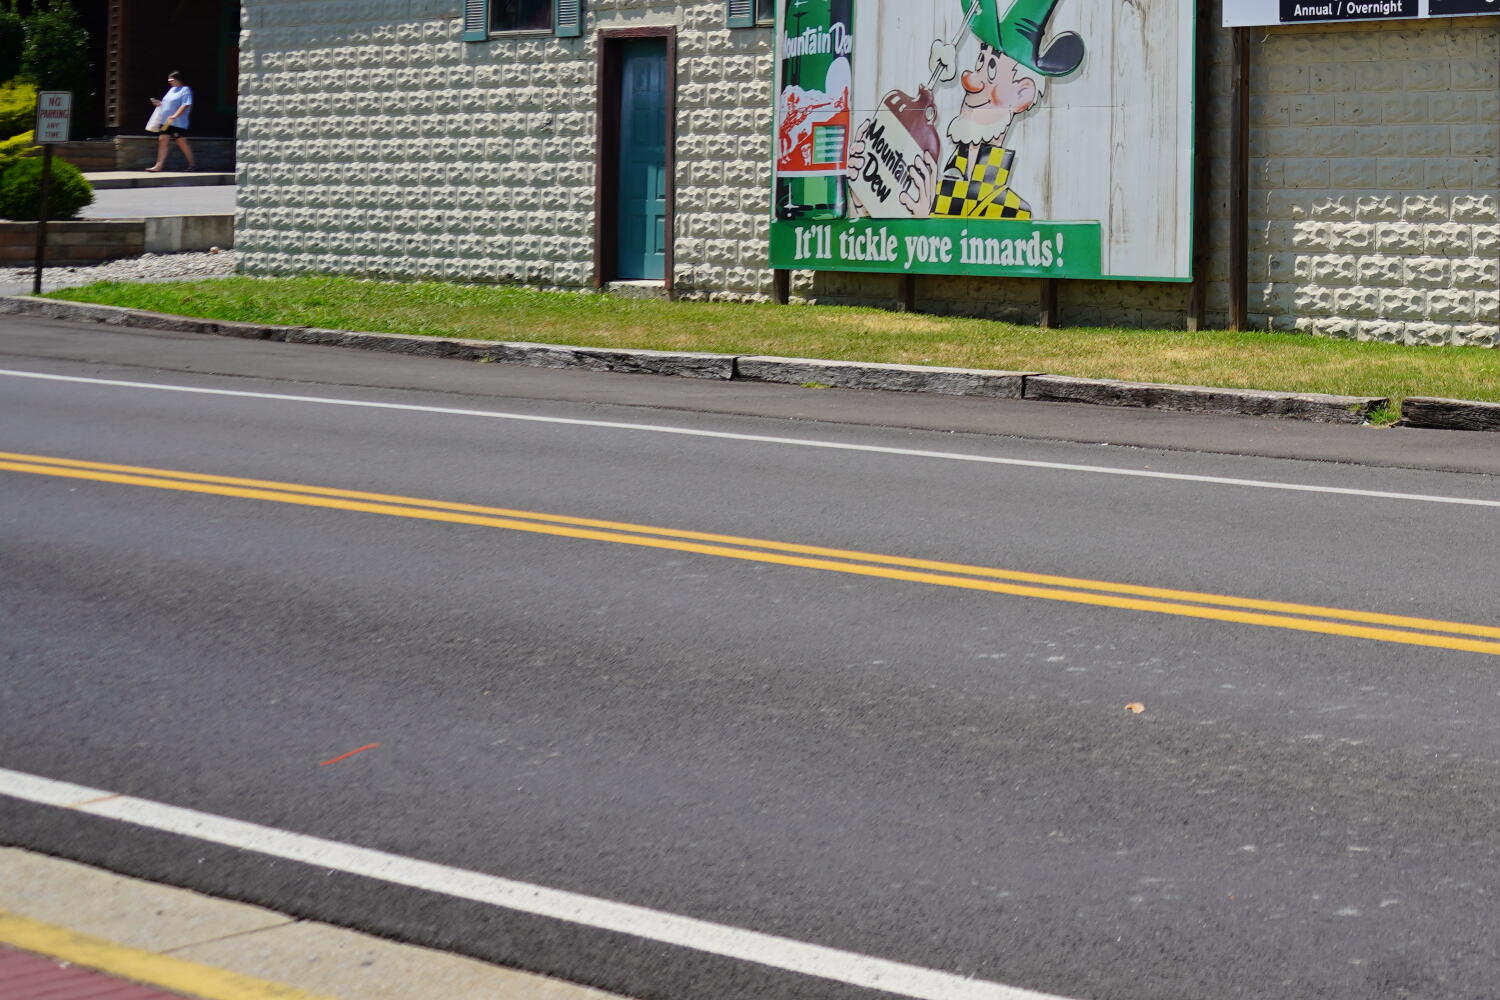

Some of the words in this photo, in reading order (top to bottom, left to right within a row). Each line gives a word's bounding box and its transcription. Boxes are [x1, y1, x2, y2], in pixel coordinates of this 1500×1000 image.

[1294, 3, 1332, 16] Annual
[1337, 2, 1342, 16] /
[1346, 0, 1402, 15] Overnight
[40, 109, 69, 118] PARKING
[48, 96, 62, 106] NO
[866, 119, 913, 192] Mountain
[863, 152, 891, 203] Dew
[794, 225, 832, 261] It'll
[839, 227, 897, 262] tickle
[903, 233, 952, 270] yore
[959, 229, 1064, 267] innards!
